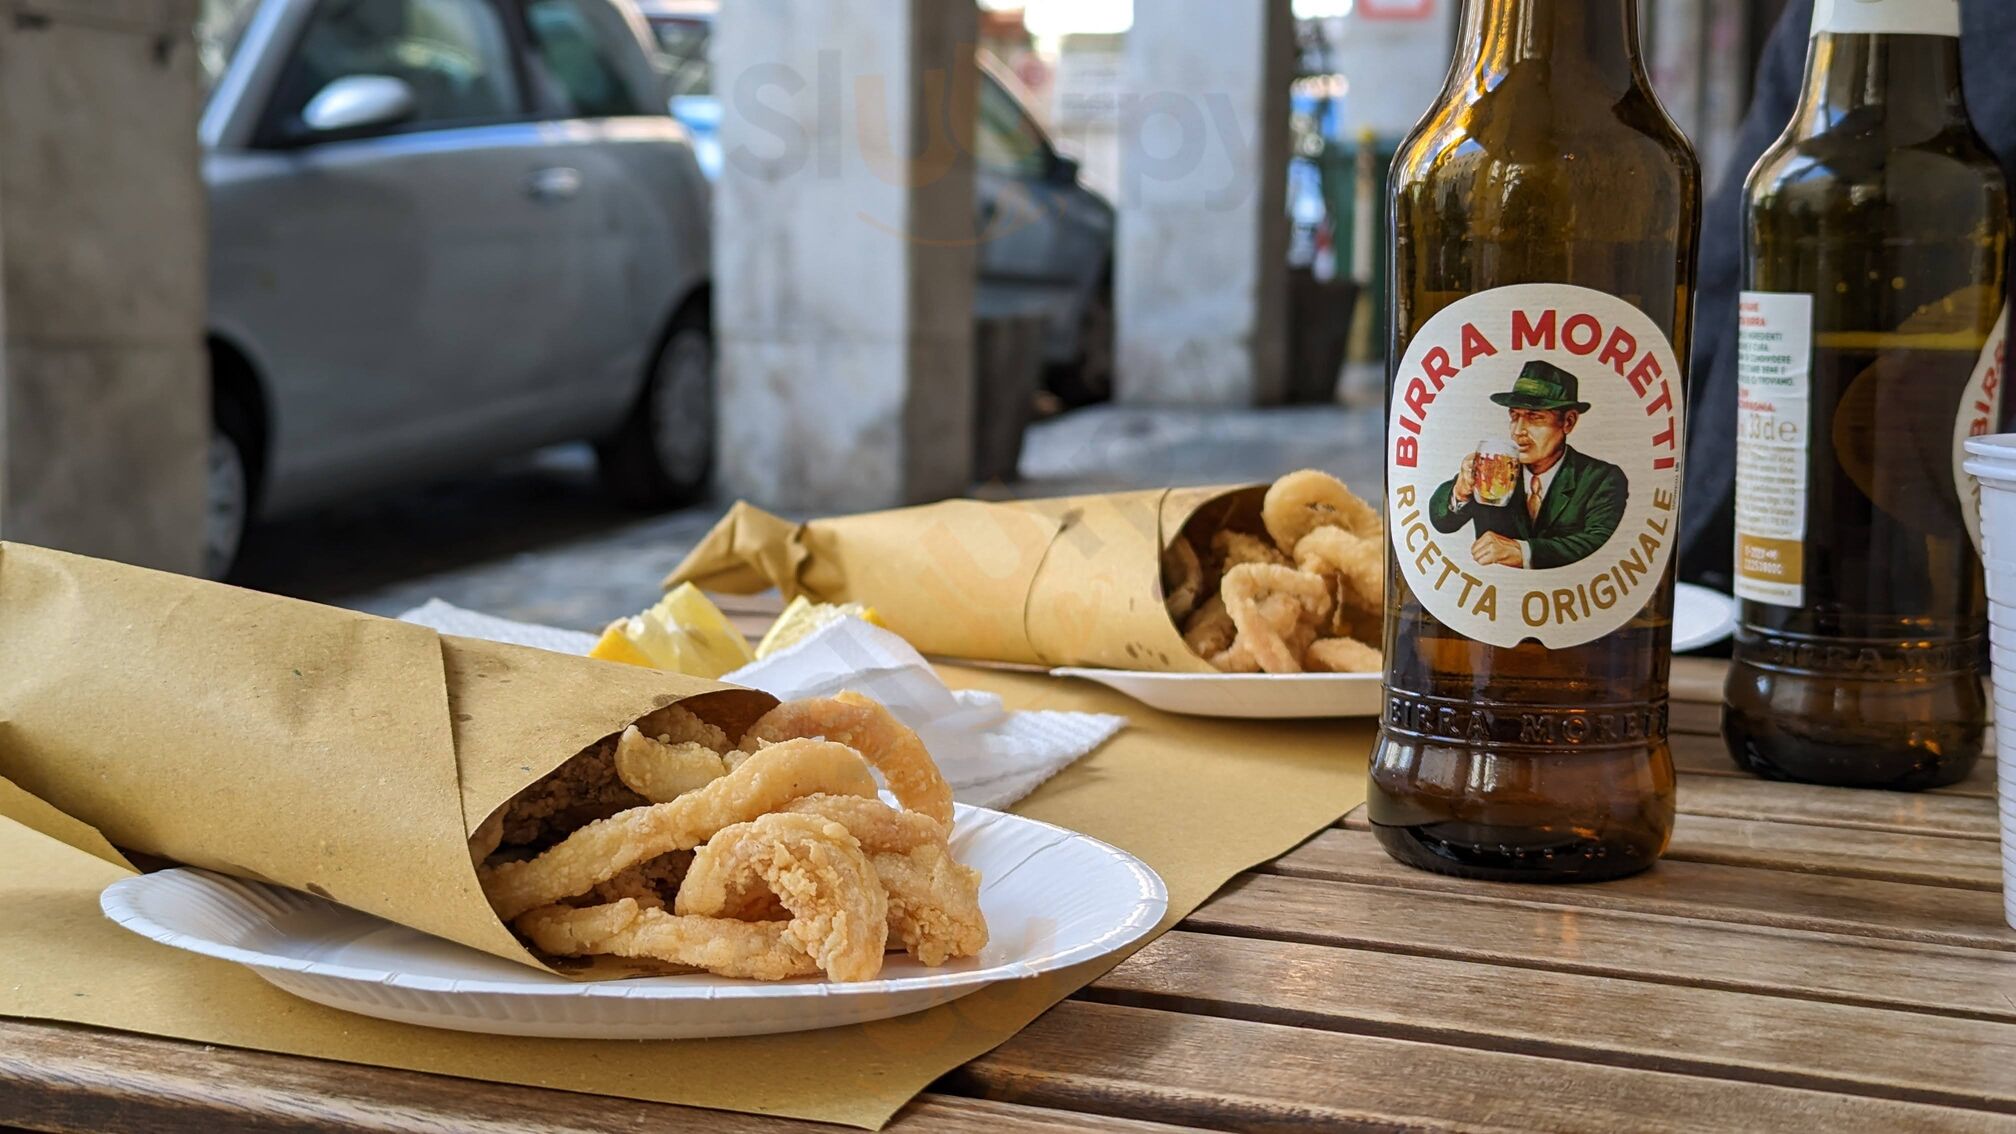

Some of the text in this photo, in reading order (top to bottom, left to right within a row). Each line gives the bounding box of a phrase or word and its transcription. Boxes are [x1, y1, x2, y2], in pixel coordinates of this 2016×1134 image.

[1395, 309, 1675, 471] BIRRA MORETTI
[1397, 484, 1498, 622] RICETTA
[1521, 487, 1673, 627] ORIGINALE
